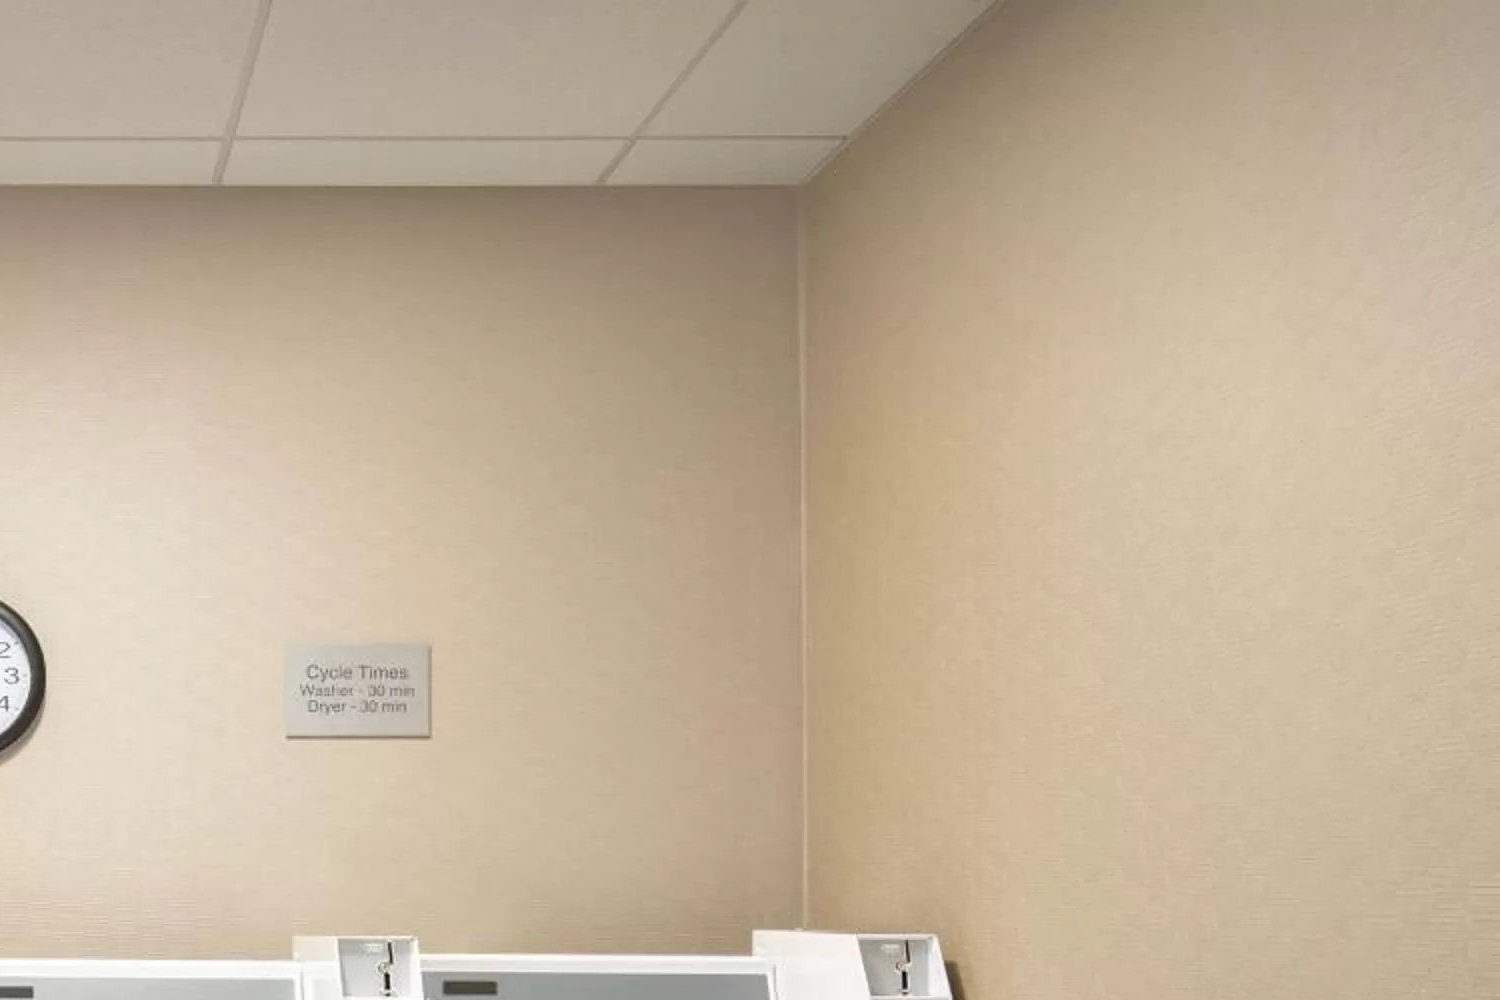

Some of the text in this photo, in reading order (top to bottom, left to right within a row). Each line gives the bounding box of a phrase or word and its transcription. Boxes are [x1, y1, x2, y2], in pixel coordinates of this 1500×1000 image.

[3, 667, 20, 685] 3
[305, 664, 410, 682] Cycle Times
[299, 684, 355, 697] Washer
[368, 685, 385, 697] 30
[389, 685, 415, 697] min
[307, 700, 346, 715] Dryer
[359, 700, 377, 713] 30
[381, 700, 407, 713] min
